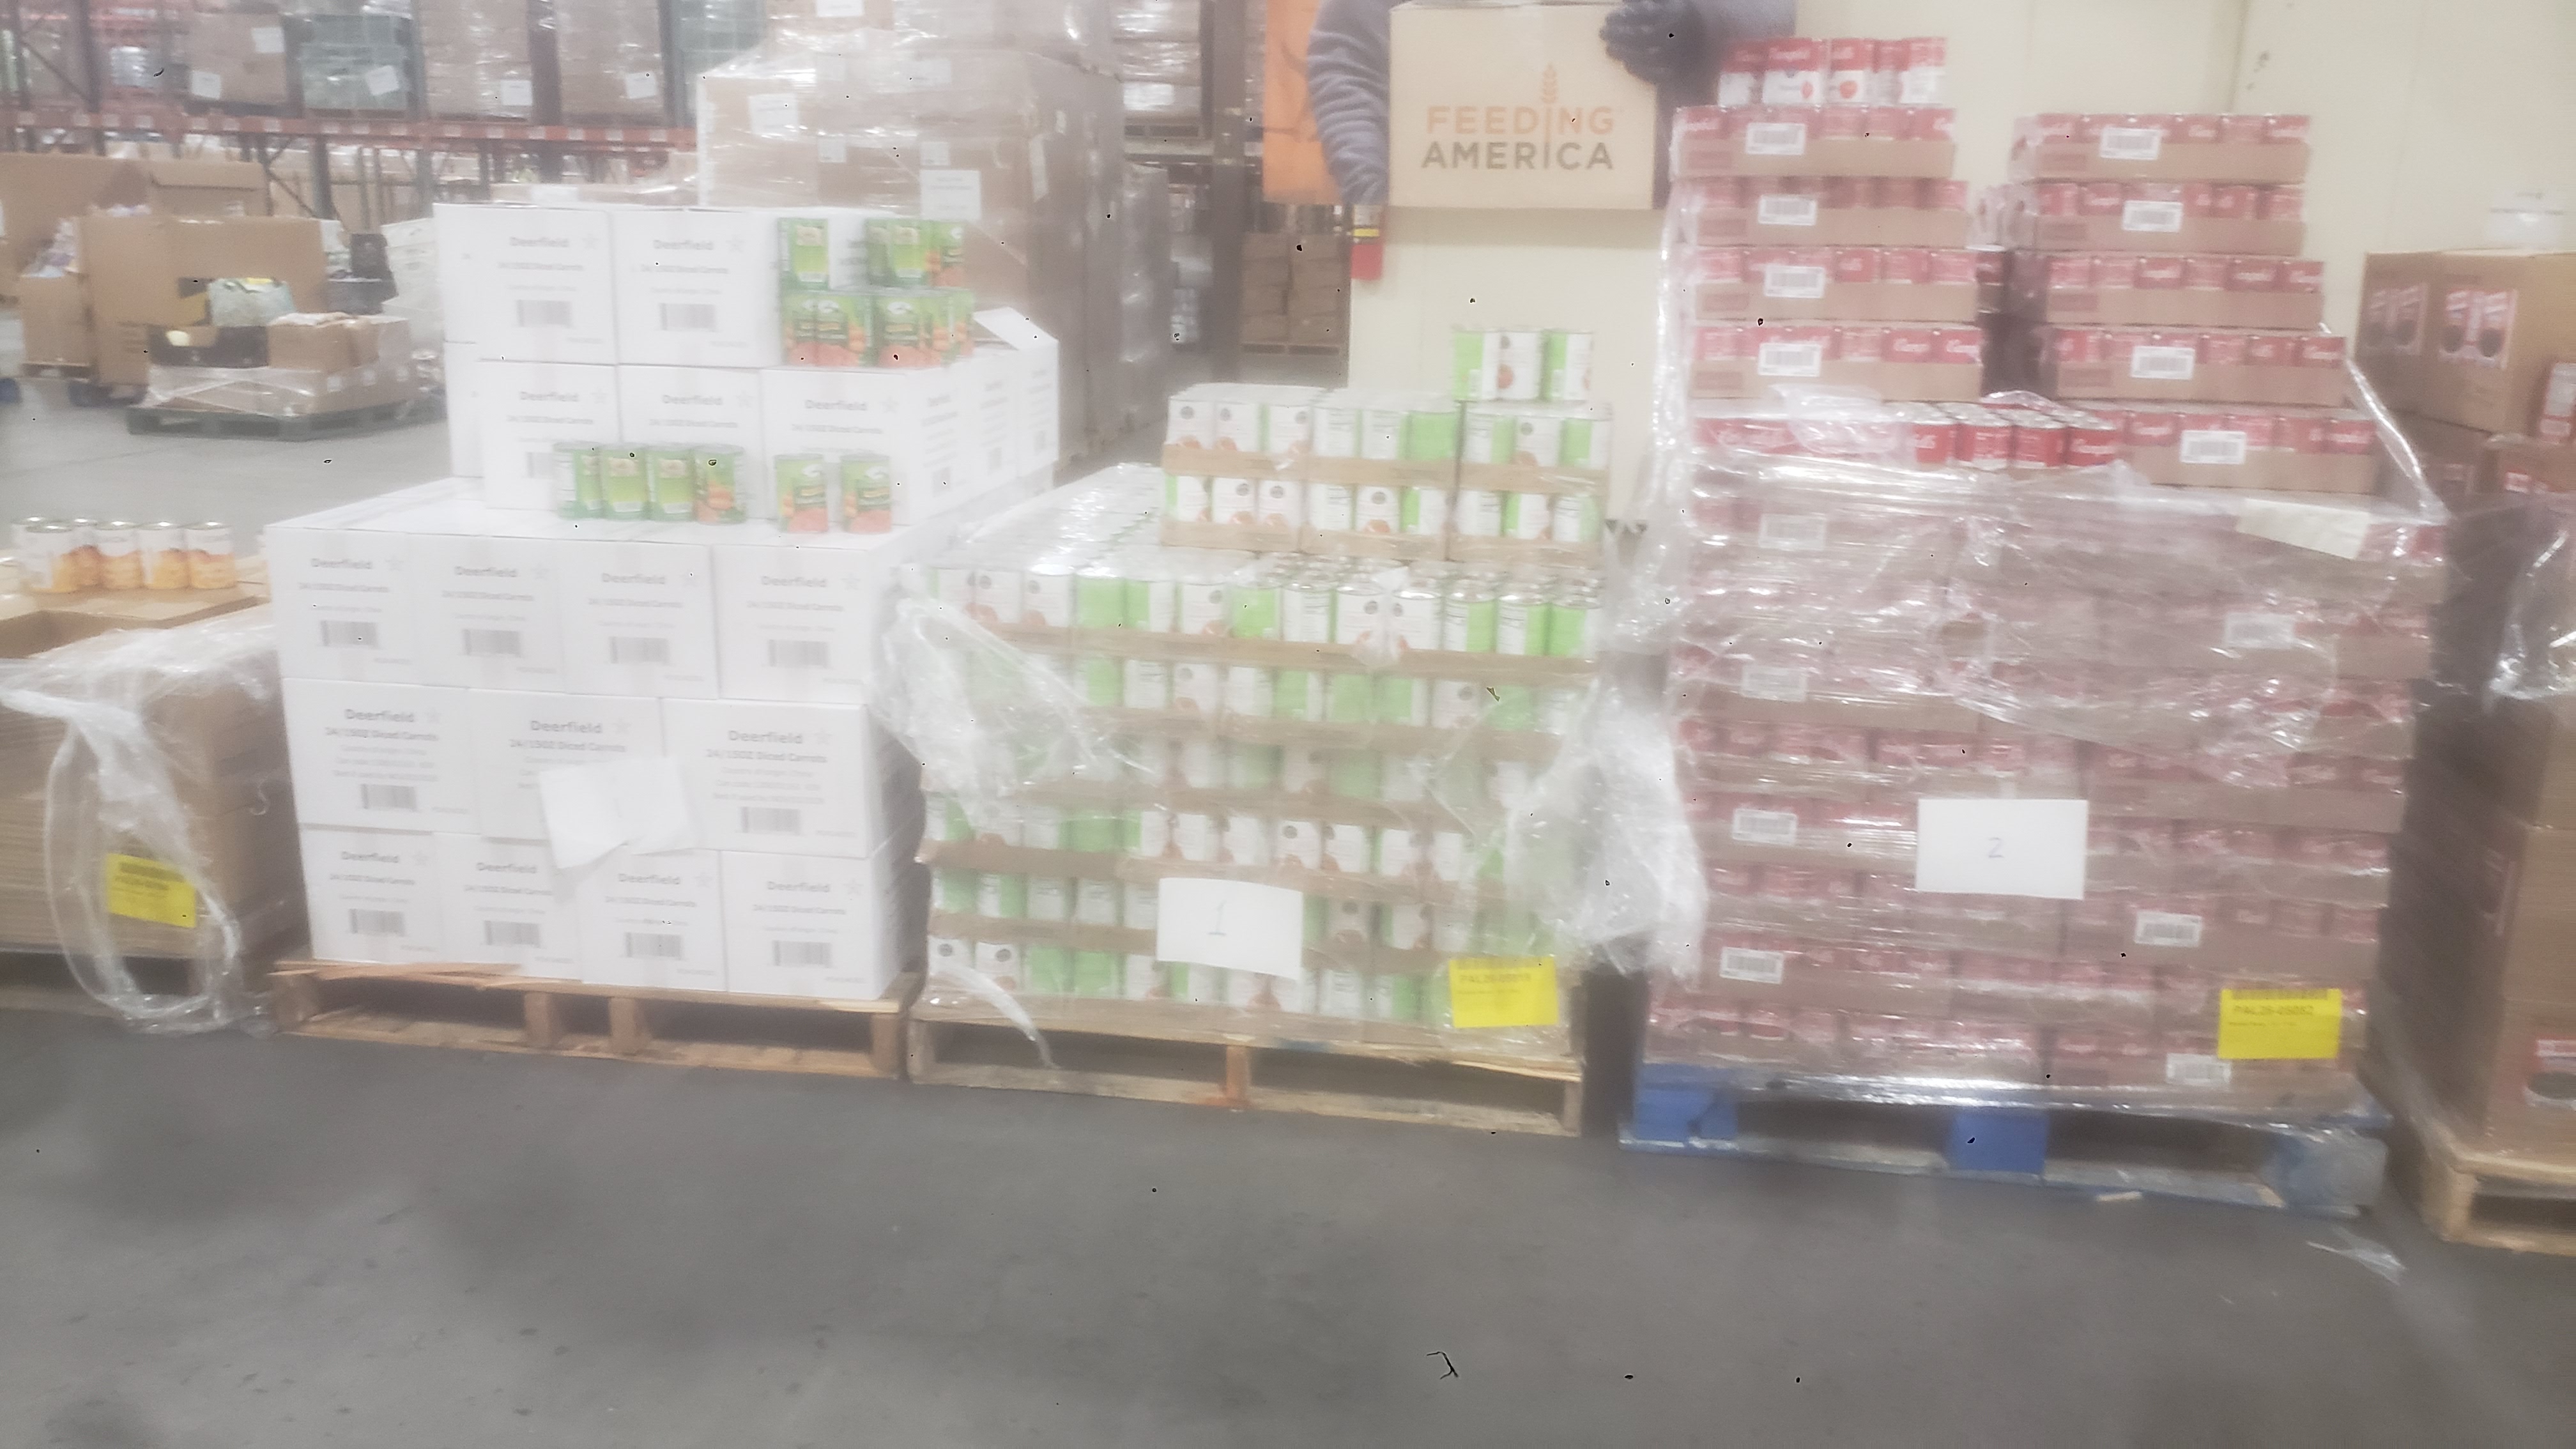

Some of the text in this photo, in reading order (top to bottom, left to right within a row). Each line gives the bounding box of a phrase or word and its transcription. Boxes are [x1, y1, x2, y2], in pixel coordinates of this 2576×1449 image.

[1426, 106, 1614, 134] FEEDING
[1421, 142, 1614, 169] AMERICA
[311, 558, 372, 569] Deerfield
[455, 566, 518, 578] Deerfield
[602, 573, 666, 584] Deerfield
[762, 576, 827, 587] Deerfield
[345, 709, 414, 722] Deerfield
[530, 721, 602, 733] Deerfield
[728, 730, 803, 744] Deerfield
[1987, 837, 2004, 859] 2
[341, 852, 399, 863] Deerfield
[477, 862, 537, 873] Deerfield
[618, 873, 680, 885] Deerfield
[767, 882, 830, 893] Deerfield
[1206, 899, 1227, 936] 1
